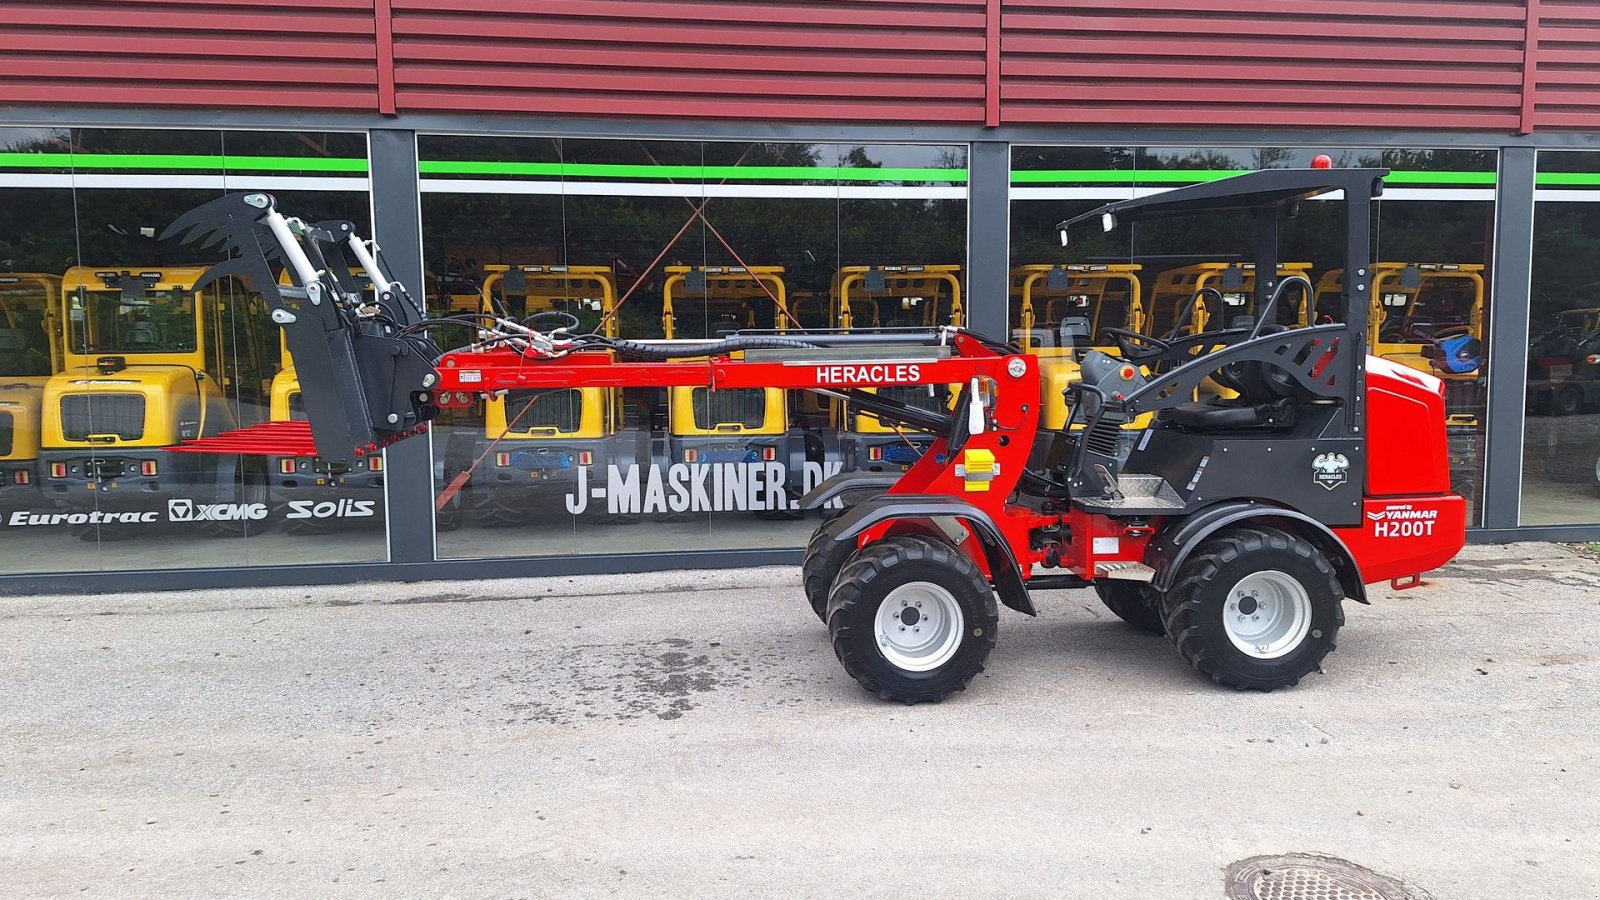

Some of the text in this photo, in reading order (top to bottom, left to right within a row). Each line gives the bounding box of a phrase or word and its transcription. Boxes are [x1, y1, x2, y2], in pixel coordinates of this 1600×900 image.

[816, 365, 920, 383] HERACLES
[8, 511, 159, 526] Eurotrac
[193, 503, 268, 521] XCMG
[1386, 510, 1438, 519] YANMAR
[1375, 520, 1435, 537] H200T
